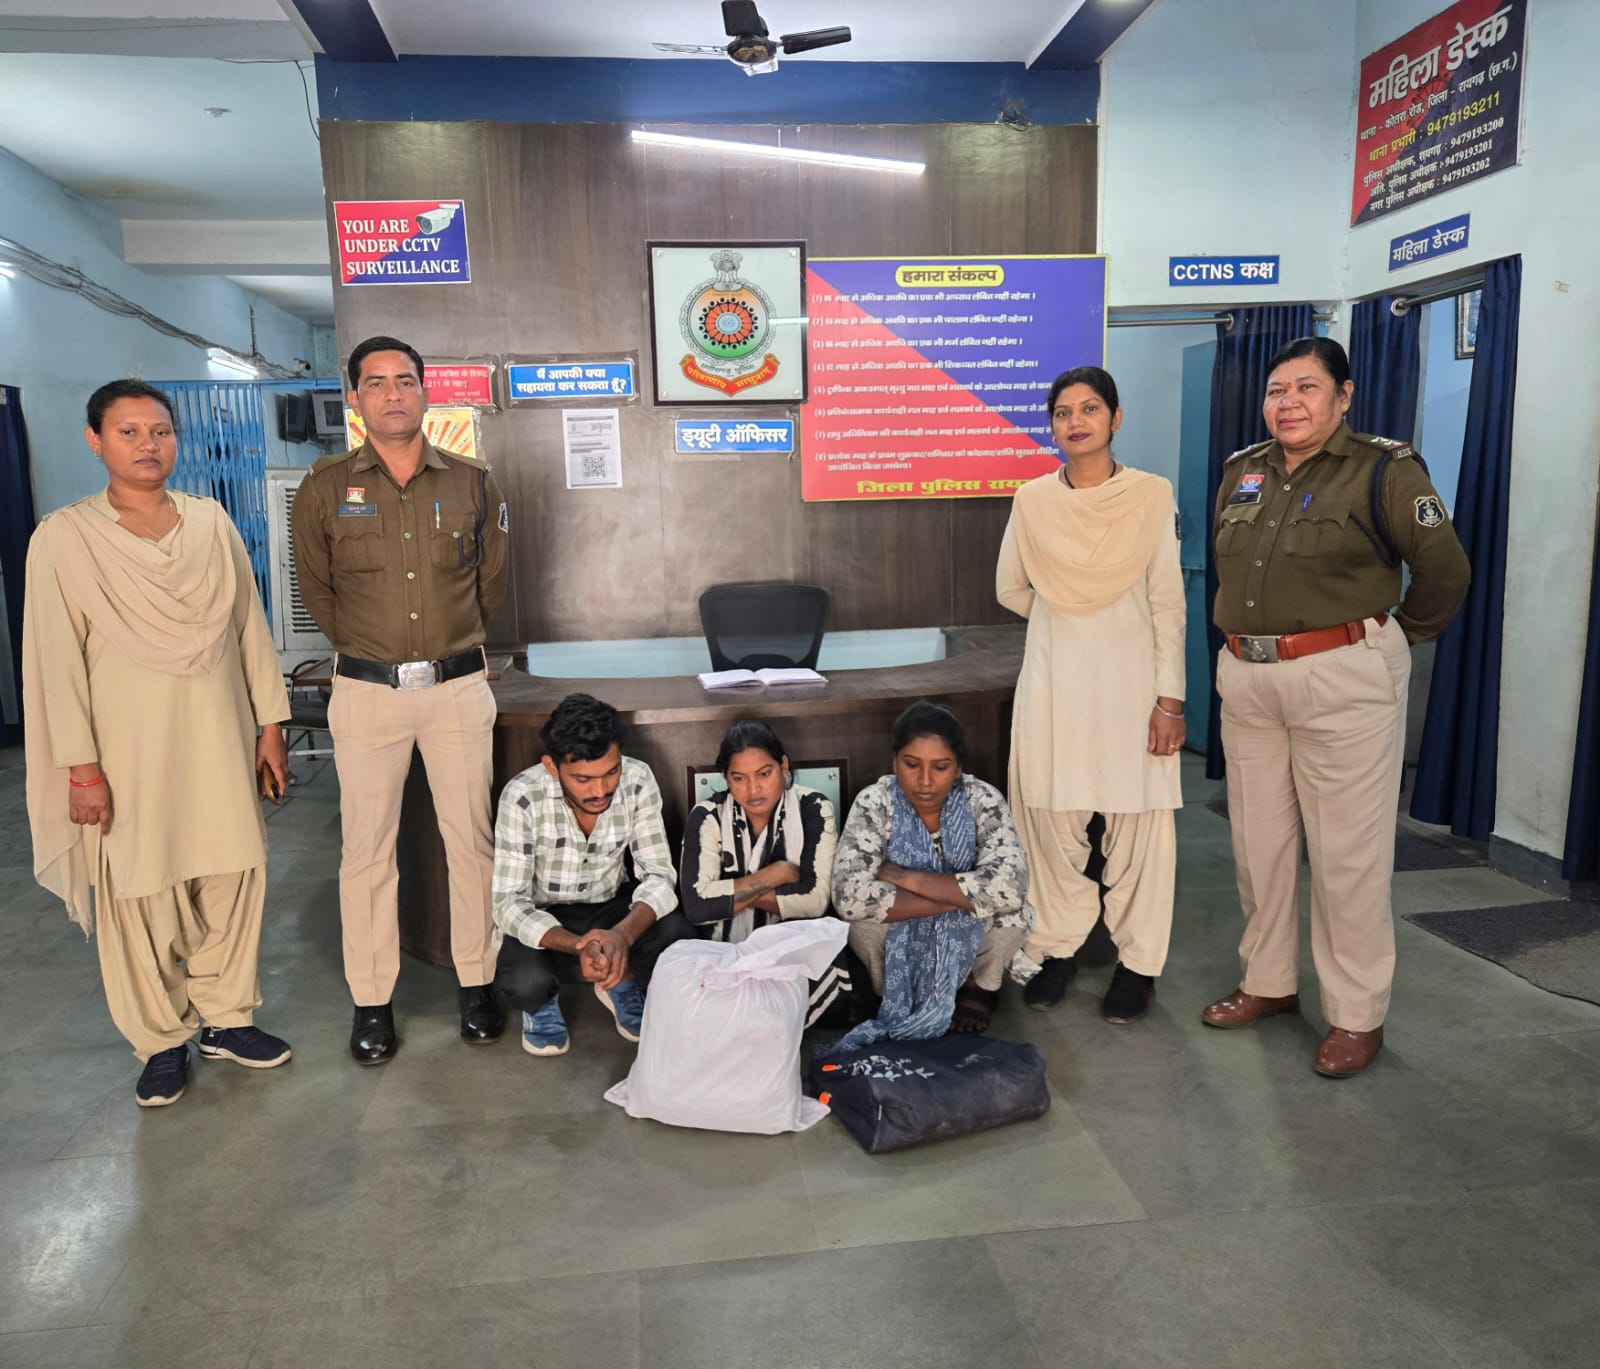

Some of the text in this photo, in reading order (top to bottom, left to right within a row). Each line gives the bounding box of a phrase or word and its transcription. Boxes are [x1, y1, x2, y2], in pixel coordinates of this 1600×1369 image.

[1369, 5, 1512, 108] महिला डेस्क
[1360, 124, 1376, 140] थाना
[1428, 90, 1447, 112] जिला
[1458, 71, 1485, 93] रायगढ़
[1369, 91, 1500, 161] थाना प्रभारी 9479193211
[1363, 168, 1382, 187] पुलिस
[1450, 116, 1504, 149] 9479193200
[1442, 157, 1490, 184] 9479193202
[342, 219, 410, 234] YOU ARE
[344, 237, 441, 253] UNDER CCTV
[1392, 225, 1466, 262] महिला डेस्क
[346, 259, 460, 275] SURVEILLANCE
[902, 266, 998, 284] हमारा संकल्प
[1173, 262, 1275, 280] CCTNS कक्ष
[548, 366, 580, 380] आपकी
[582, 367, 607, 379] क्या
[516, 381, 555, 395] सहायता
[558, 381, 575, 392] कर
[577, 380, 609, 392] सकता
[681, 423, 788, 448] ड्यूटी ऑफिसर
[857, 478, 1031, 494] जिला पुलिस राय
